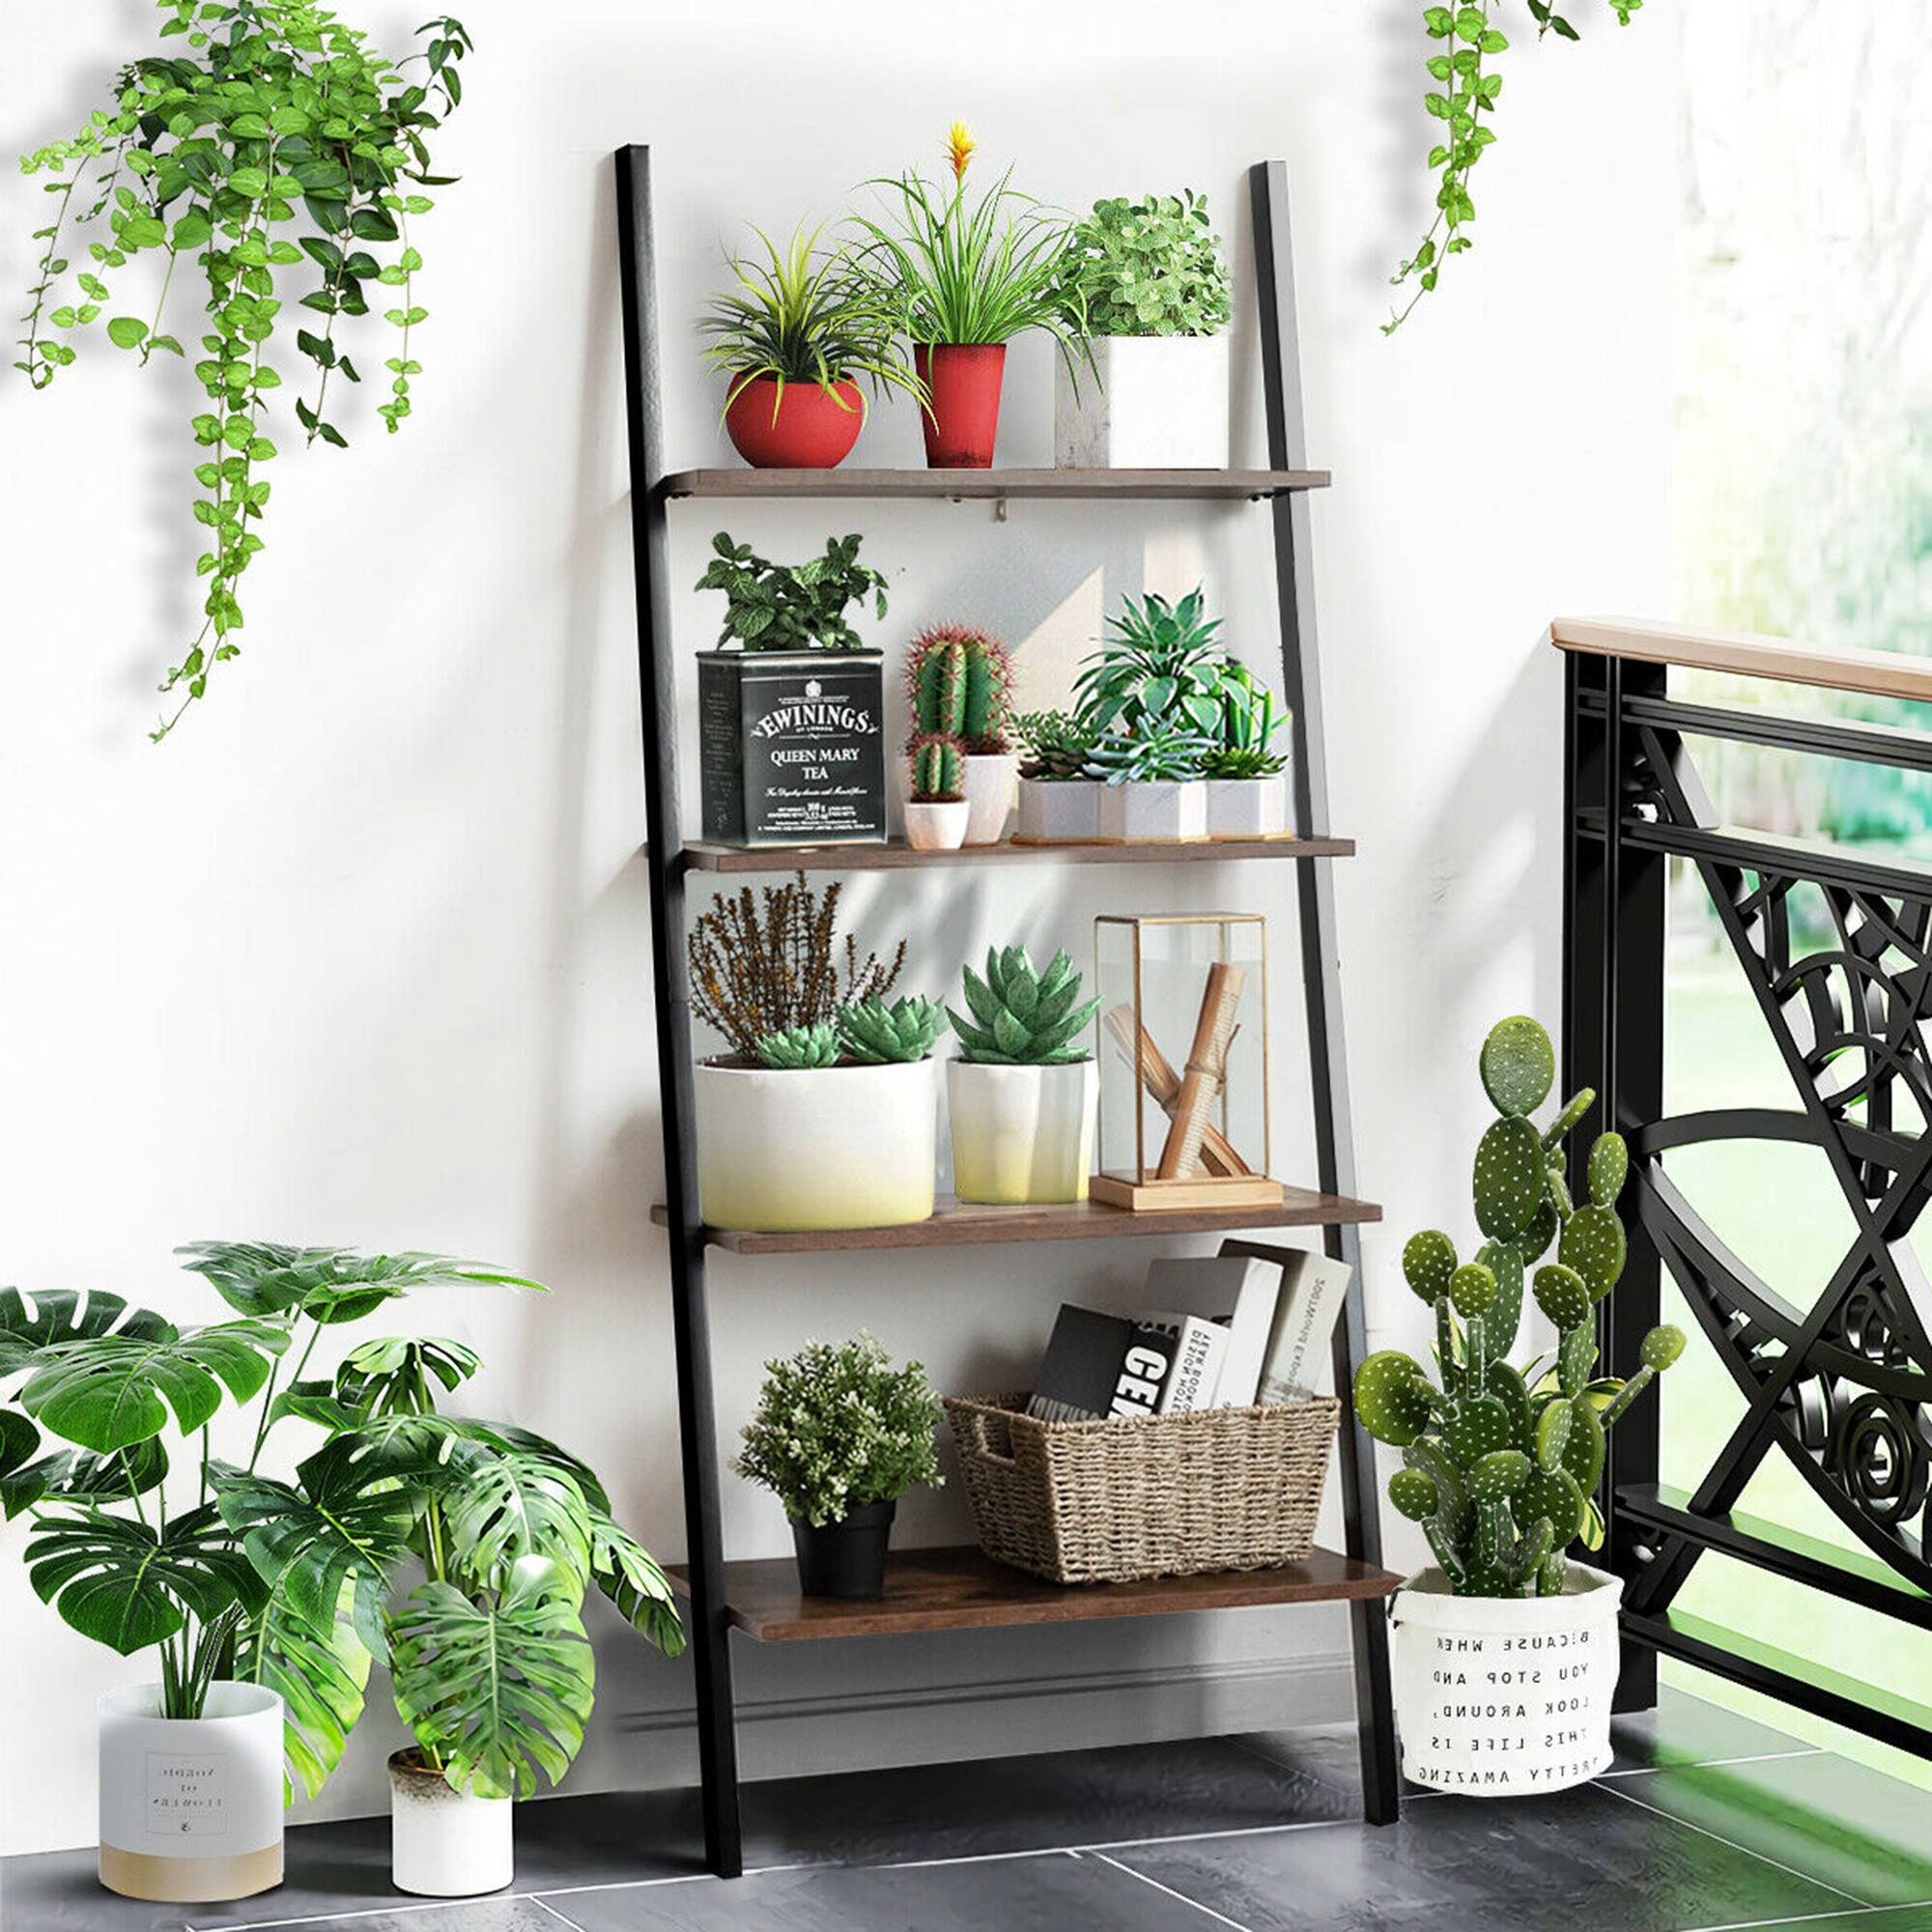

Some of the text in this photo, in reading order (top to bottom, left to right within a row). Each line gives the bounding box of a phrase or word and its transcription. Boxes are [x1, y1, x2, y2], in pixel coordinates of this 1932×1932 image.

[771, 748, 860, 766] QUEEN MARY
[802, 766, 829, 780] TEA
